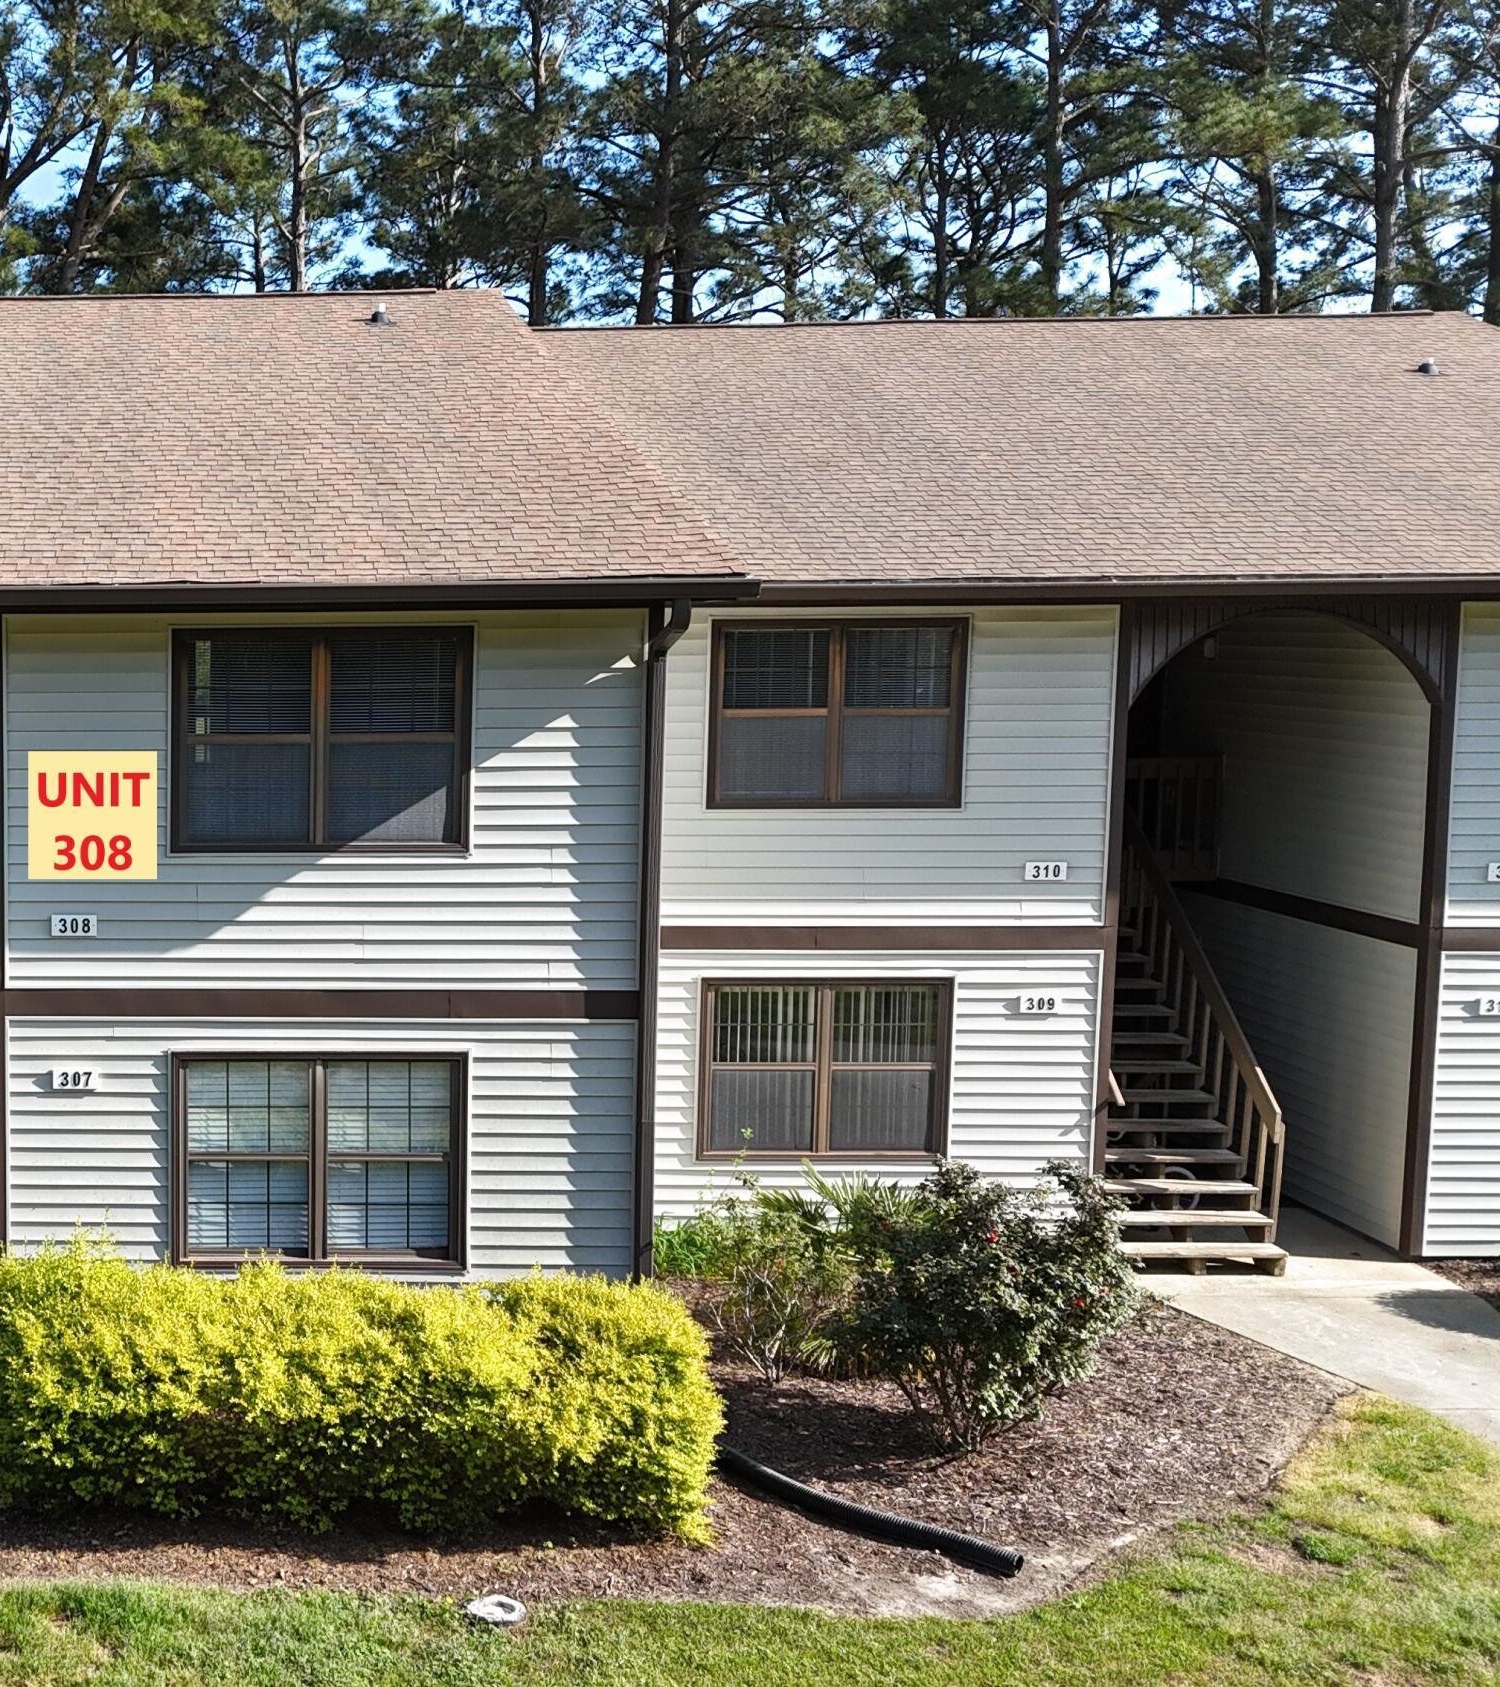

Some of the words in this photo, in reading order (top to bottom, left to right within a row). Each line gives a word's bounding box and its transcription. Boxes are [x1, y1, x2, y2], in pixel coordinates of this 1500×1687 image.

[1032, 864, 1061, 878] 310
[58, 918, 91, 933] 308
[1025, 997, 1055, 1010] 309
[59, 1071, 92, 1087] 307
